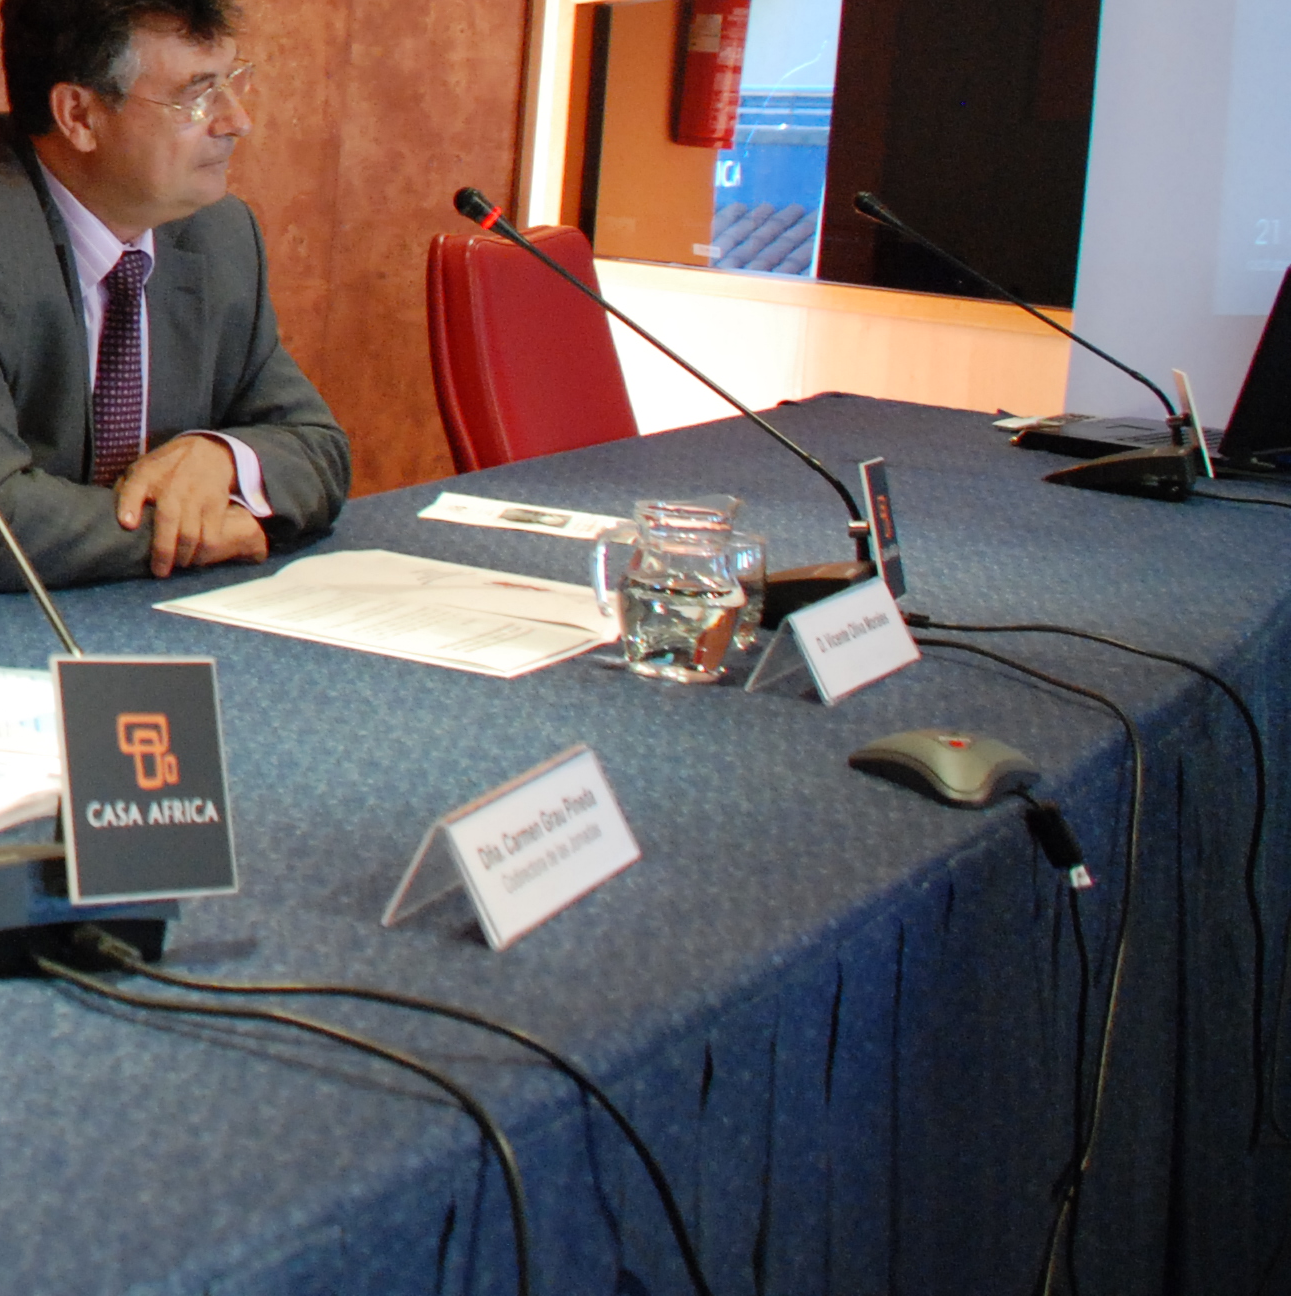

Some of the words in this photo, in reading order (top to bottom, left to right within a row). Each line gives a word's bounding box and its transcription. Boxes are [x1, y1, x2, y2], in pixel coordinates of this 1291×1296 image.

[86, 799, 144, 828] CASA
[148, 797, 219, 825] AFRICA
[503, 822, 544, 854] Carmen
[539, 808, 568, 833] Grau
[563, 789, 596, 818] Pineda
